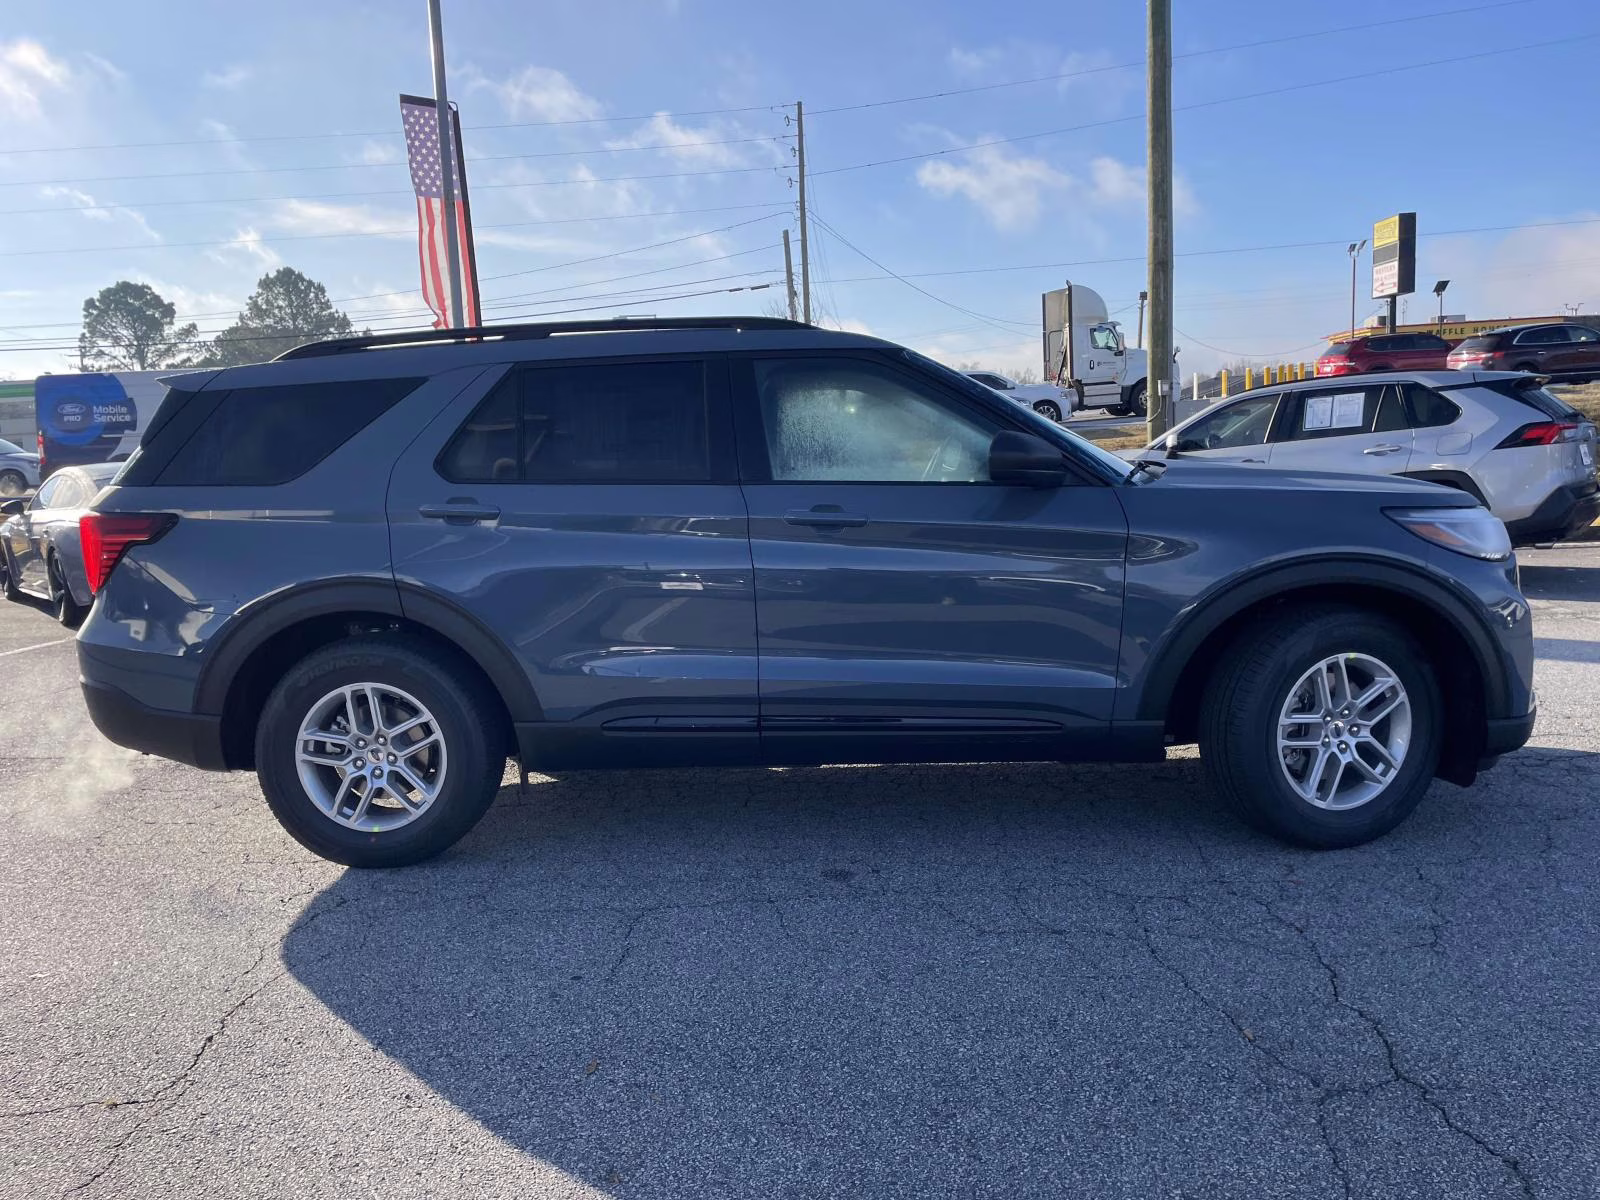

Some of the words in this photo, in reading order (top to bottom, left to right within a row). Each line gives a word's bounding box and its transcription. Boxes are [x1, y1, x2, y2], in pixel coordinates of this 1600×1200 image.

[1426, 327, 1465, 336] WAFFLE
[93, 405, 127, 414] Mobile
[94, 413, 131, 422] Service
